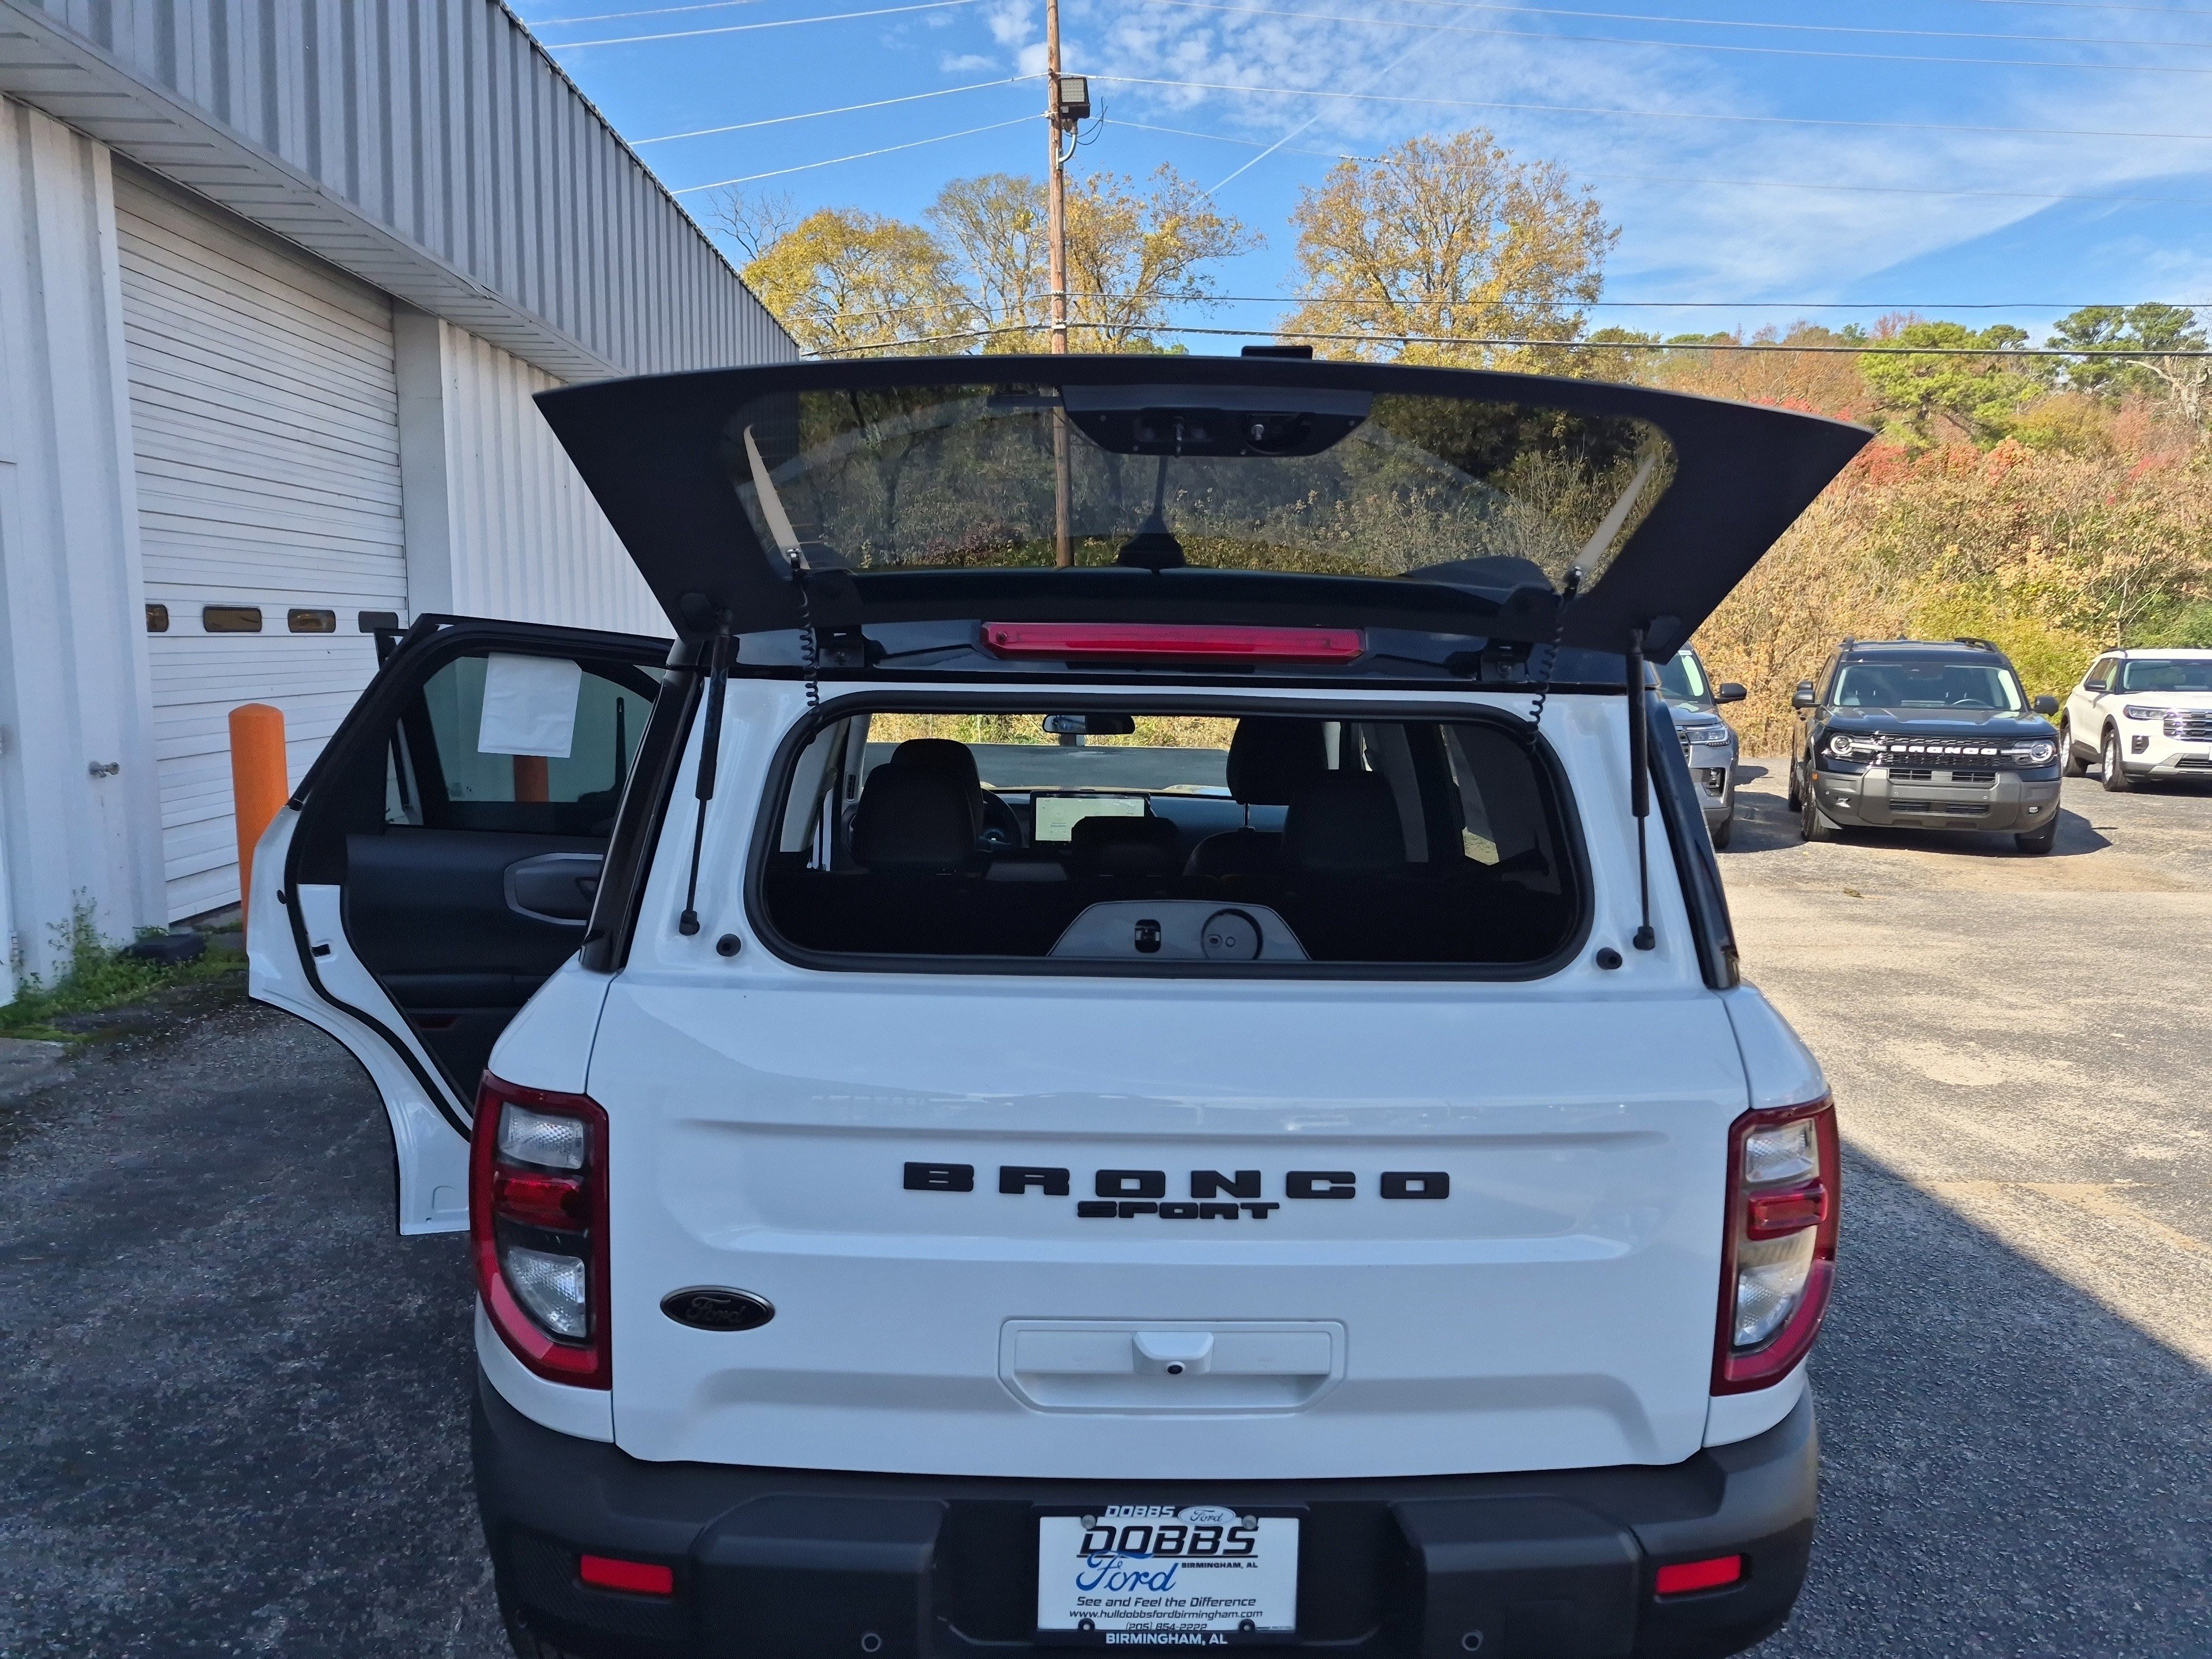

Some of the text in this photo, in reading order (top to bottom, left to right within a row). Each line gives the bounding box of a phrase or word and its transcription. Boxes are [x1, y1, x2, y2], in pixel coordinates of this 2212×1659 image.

[1891, 745, 1997, 755] BRONCO
[903, 1161, 1450, 1200] BRONCO
[1077, 1200, 1280, 1220] SPORT
[1104, 1506, 1224, 1522] DOBBS Ford
[1079, 1526, 1259, 1555] DOBBS
[1076, 1549, 1179, 1592] Ford
[1076, 1596, 1256, 1607] See and Feel the Difference
[1069, 1609, 1263, 1621] www.hulldobbsfordbirmingham.com
[1125, 1622, 1153, 1630] (205)
[1105, 1632, 1229, 1646] BIRMINGHAM, AL
